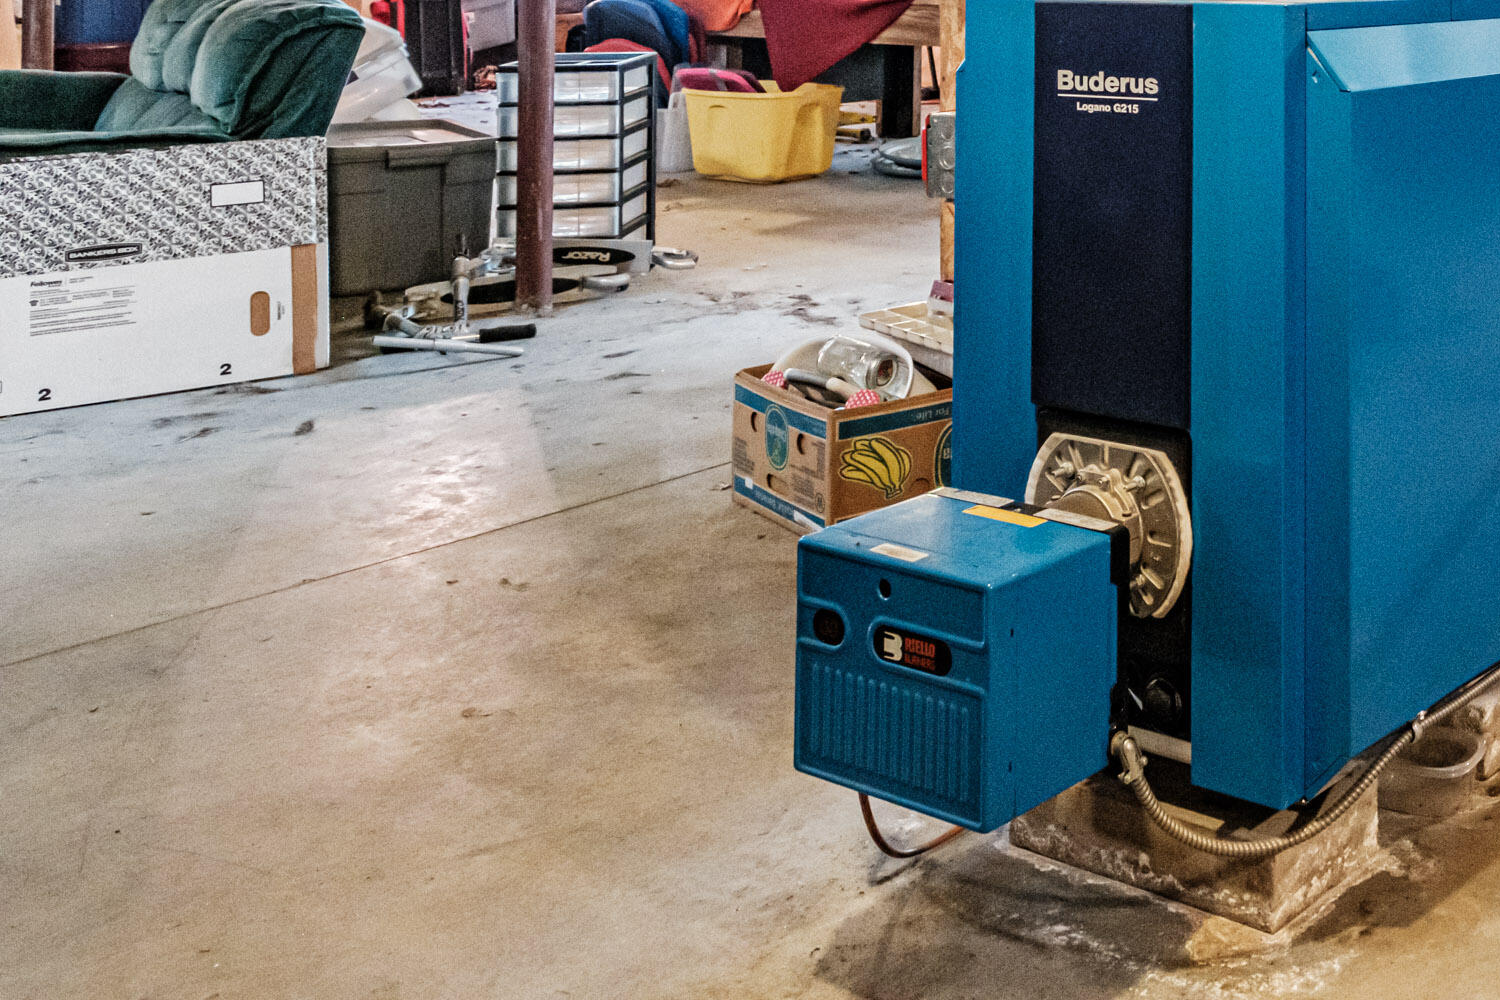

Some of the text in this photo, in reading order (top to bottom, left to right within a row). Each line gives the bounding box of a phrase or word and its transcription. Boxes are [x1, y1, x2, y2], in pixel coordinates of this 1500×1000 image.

[1057, 69, 1159, 95] Buderus
[1076, 101, 1139, 114] Logano G215
[69, 246, 139, 259] BANKERS BOX
[561, 251, 611, 262] Razor
[219, 363, 232, 376] 2
[38, 388, 51, 401] 2
[904, 637, 936, 658] RIELLO
